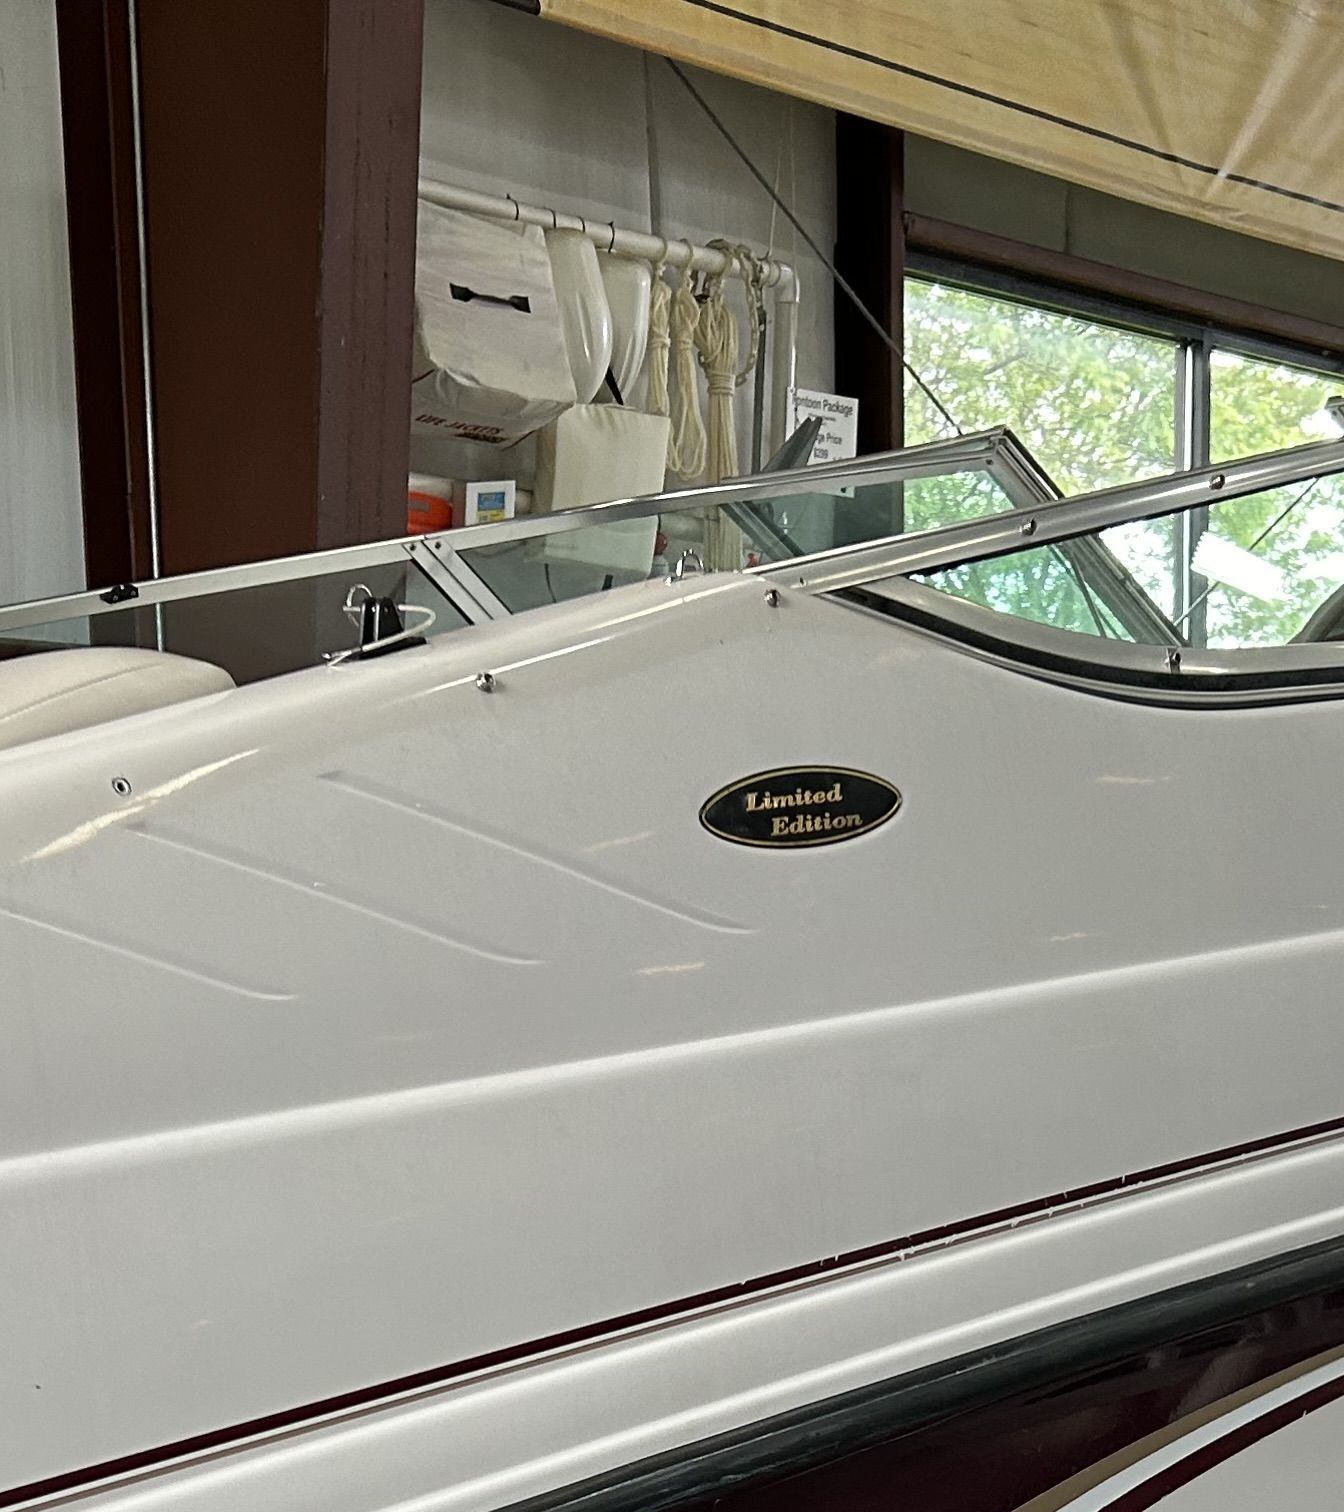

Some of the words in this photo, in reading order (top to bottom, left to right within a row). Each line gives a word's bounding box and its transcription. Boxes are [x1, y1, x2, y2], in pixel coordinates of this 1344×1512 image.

[823, 399, 853, 418] Package
[416, 414, 447, 425] LIFE
[445, 421, 504, 435] JACKETS
[745, 783, 843, 812] Limited
[770, 812, 863, 837] Edition
